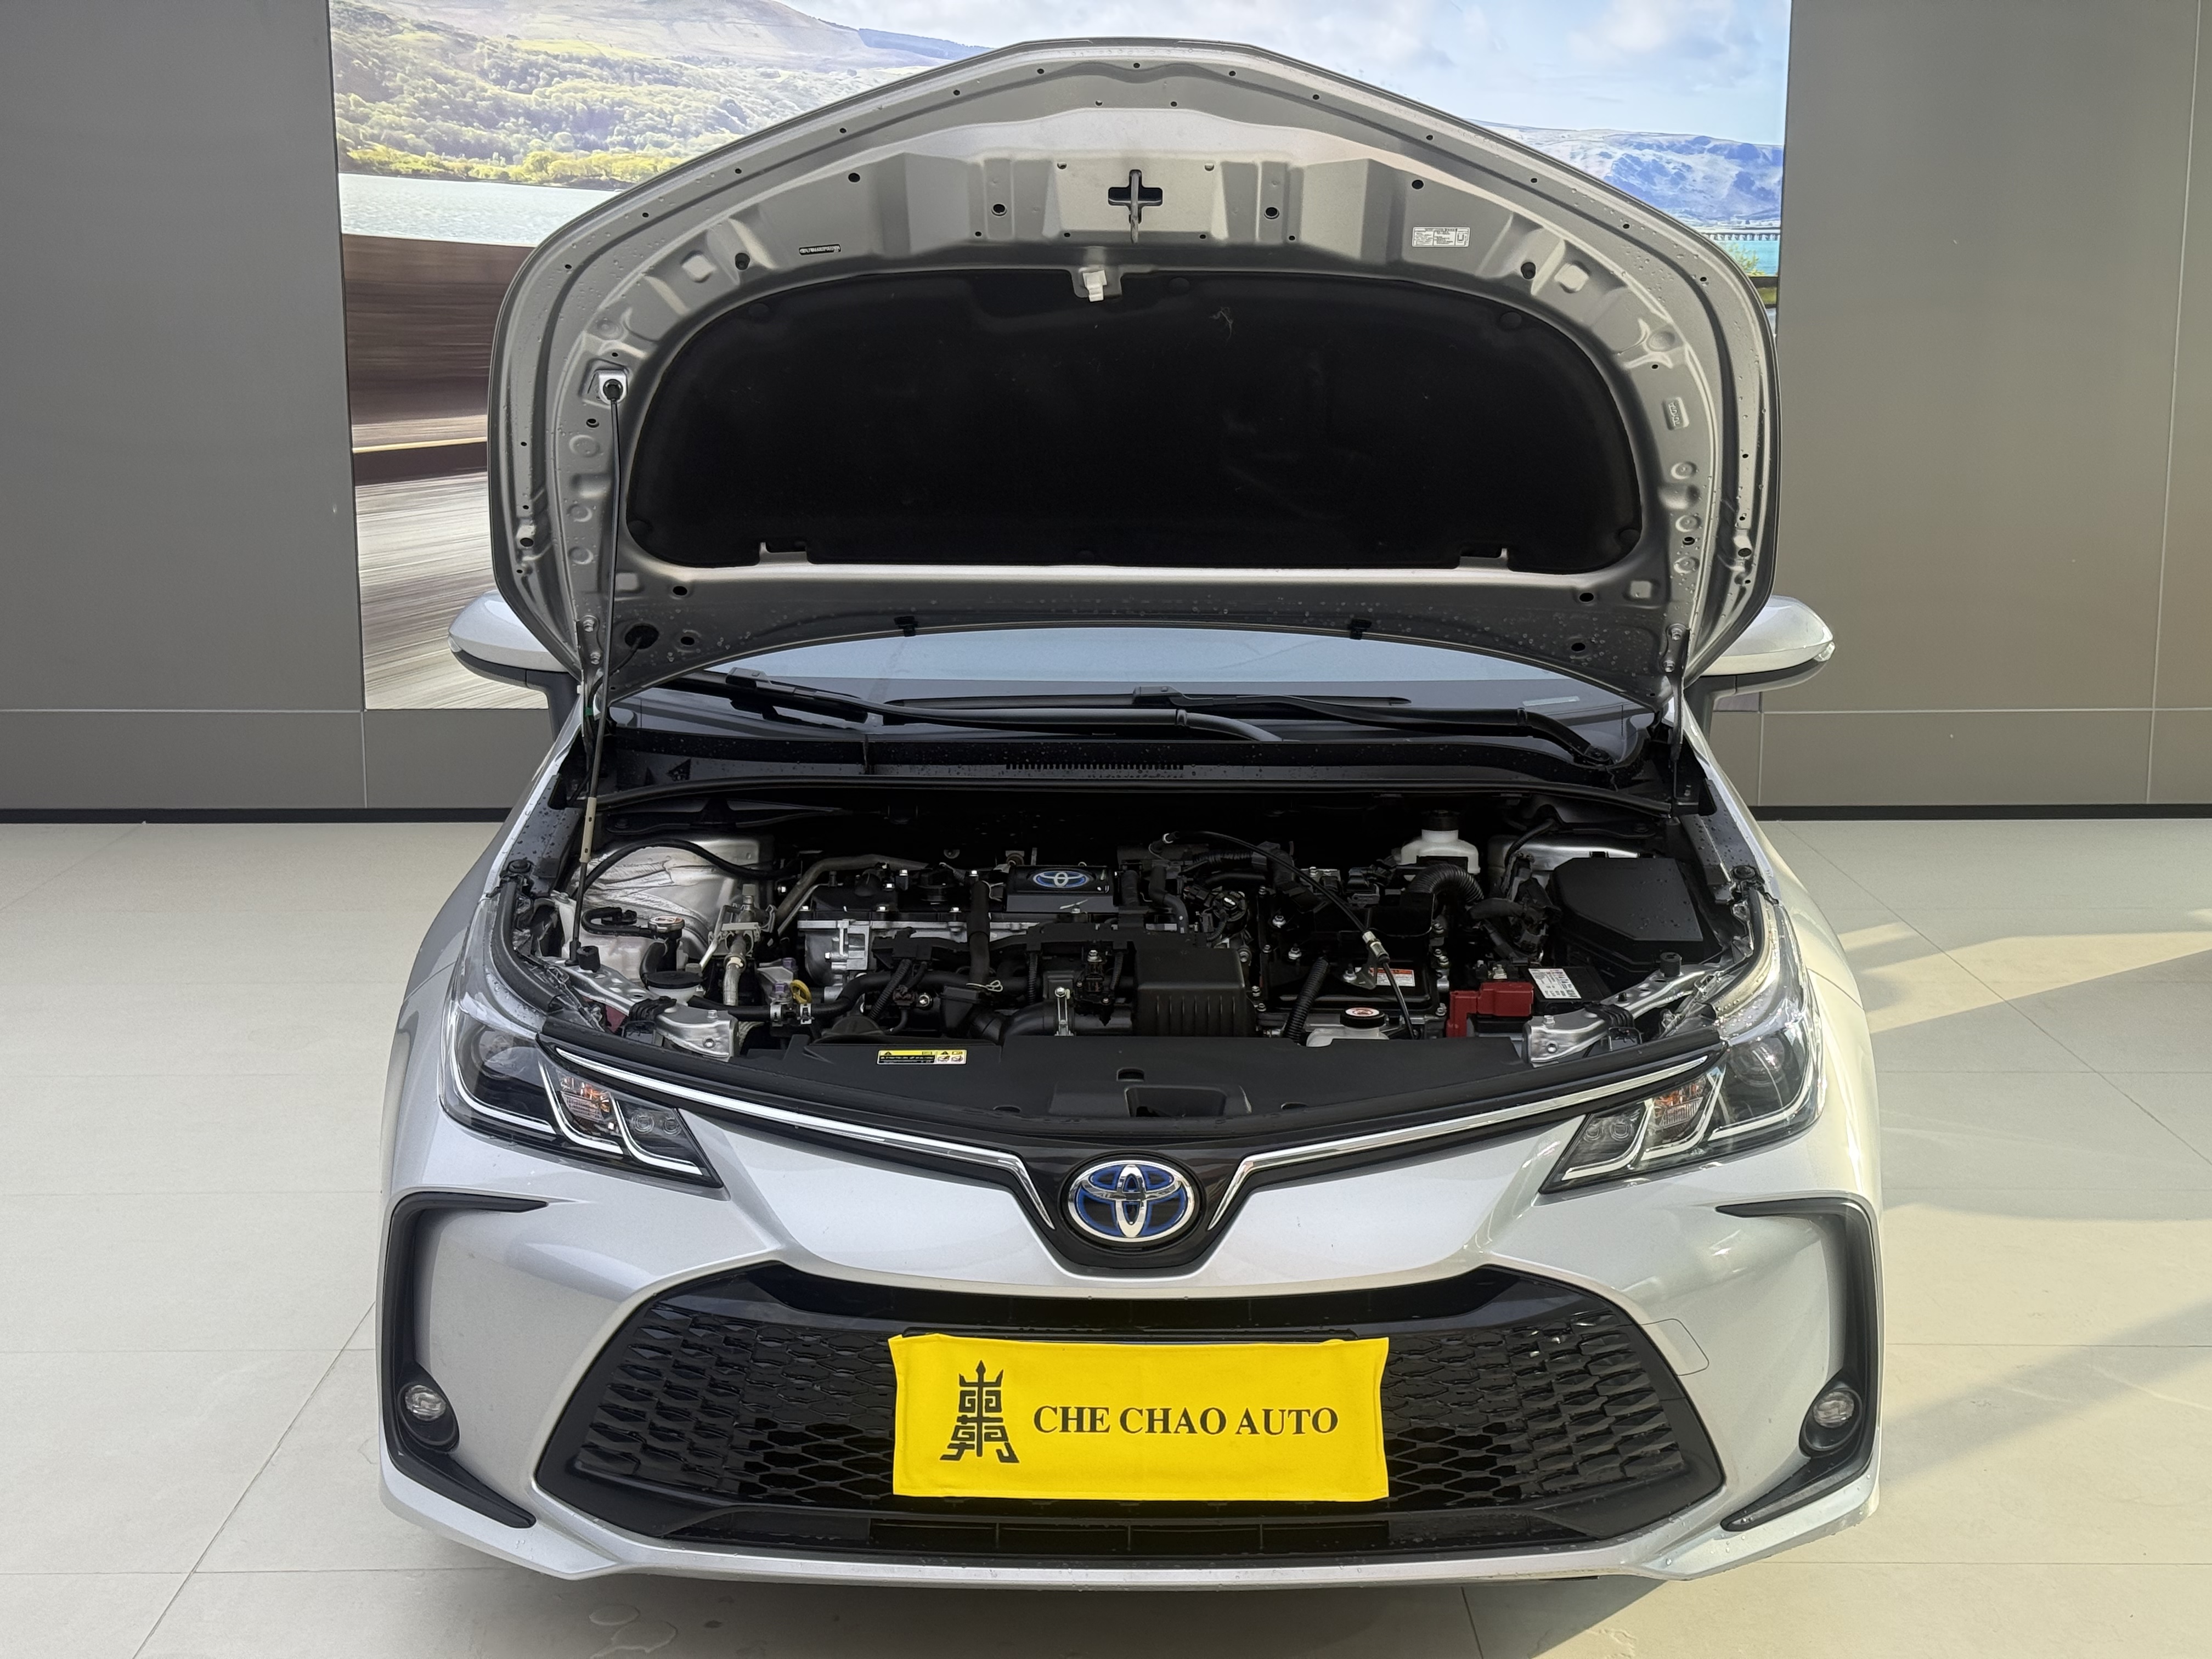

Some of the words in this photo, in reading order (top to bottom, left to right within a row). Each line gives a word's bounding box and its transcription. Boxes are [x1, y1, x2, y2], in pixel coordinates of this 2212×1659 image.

[1034, 1406, 1110, 1433] CHE
[1120, 1407, 1227, 1435] CHAO
[1235, 1407, 1338, 1435] AUTO
